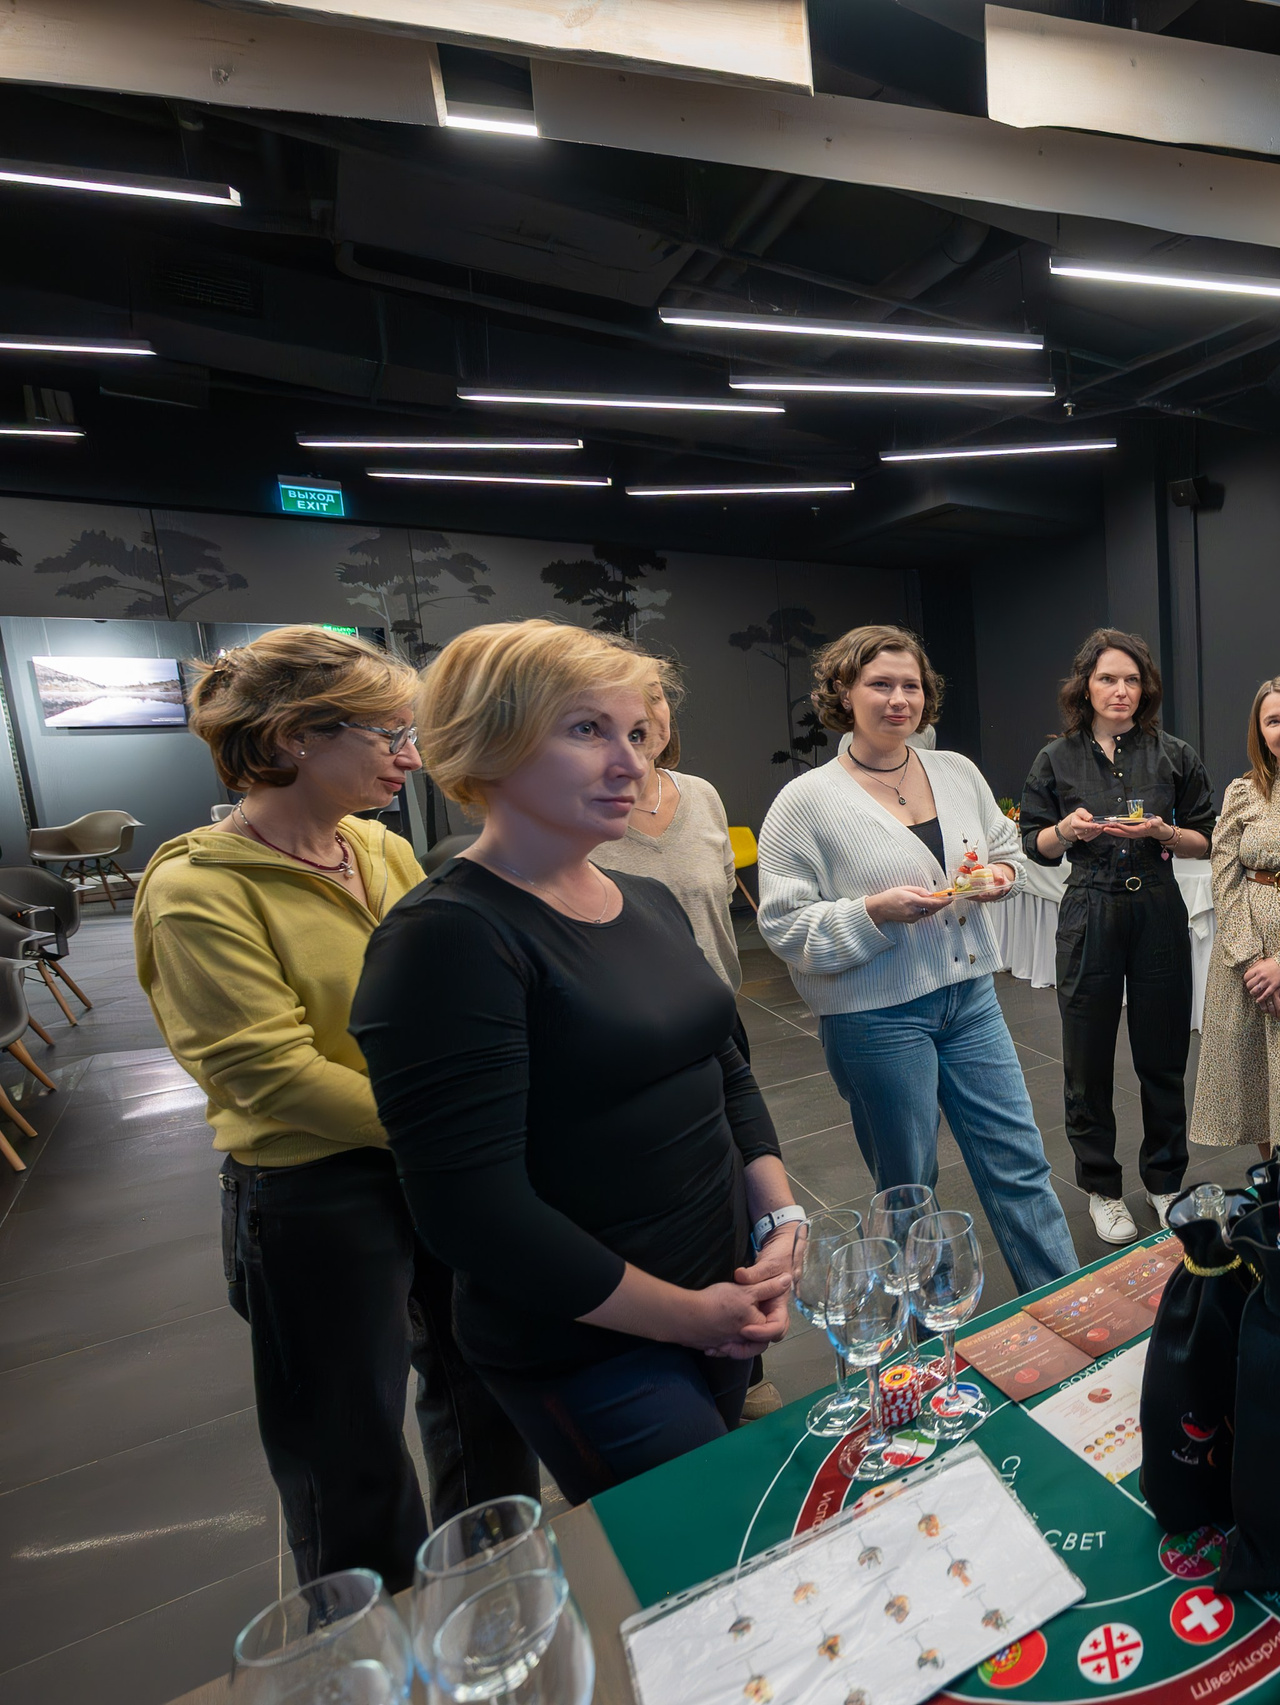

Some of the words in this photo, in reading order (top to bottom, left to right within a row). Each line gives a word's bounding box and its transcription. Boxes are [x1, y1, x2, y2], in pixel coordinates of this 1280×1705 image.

[288, 490, 335, 503] ВЫХОД
[297, 500, 328, 512] EXIT
[1043, 1529, 1107, 1551] СВЕТ
